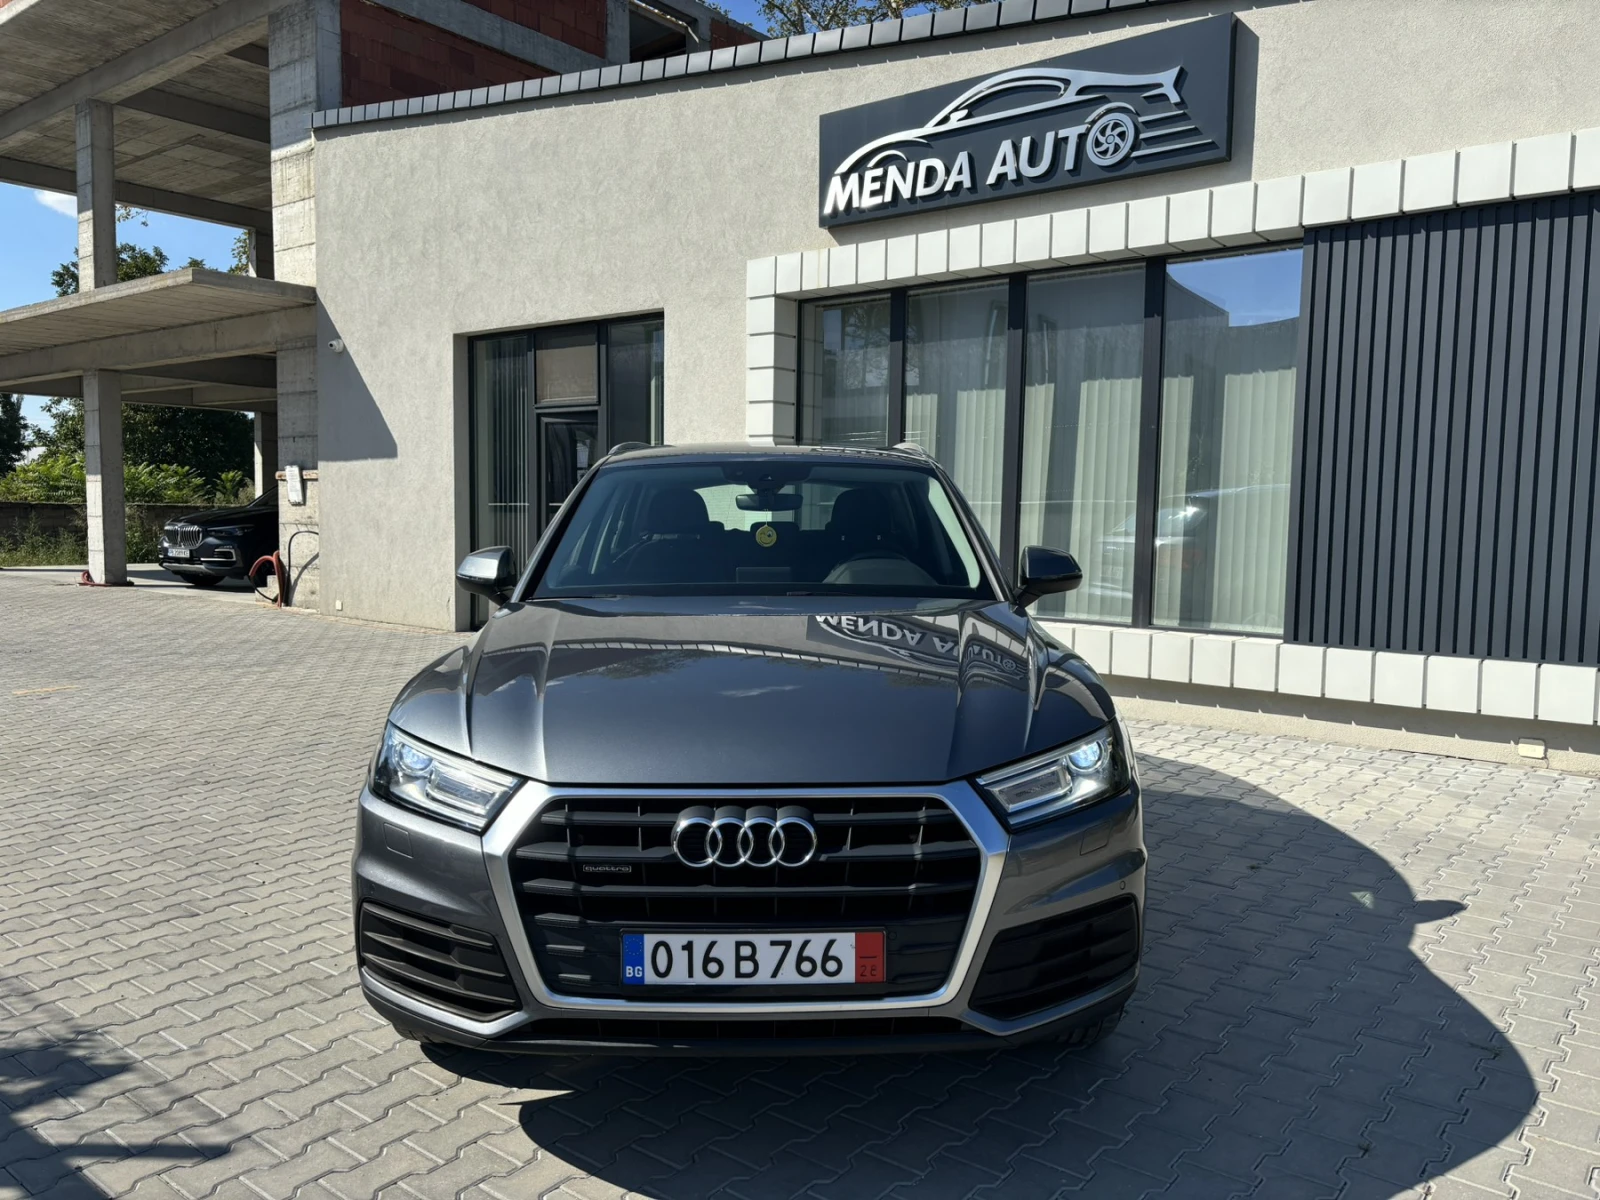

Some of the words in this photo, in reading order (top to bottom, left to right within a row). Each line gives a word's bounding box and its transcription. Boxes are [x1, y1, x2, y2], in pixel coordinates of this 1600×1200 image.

[823, 150, 972, 214] MENDA
[986, 112, 1137, 186] AUTO
[625, 966, 643, 978] BG
